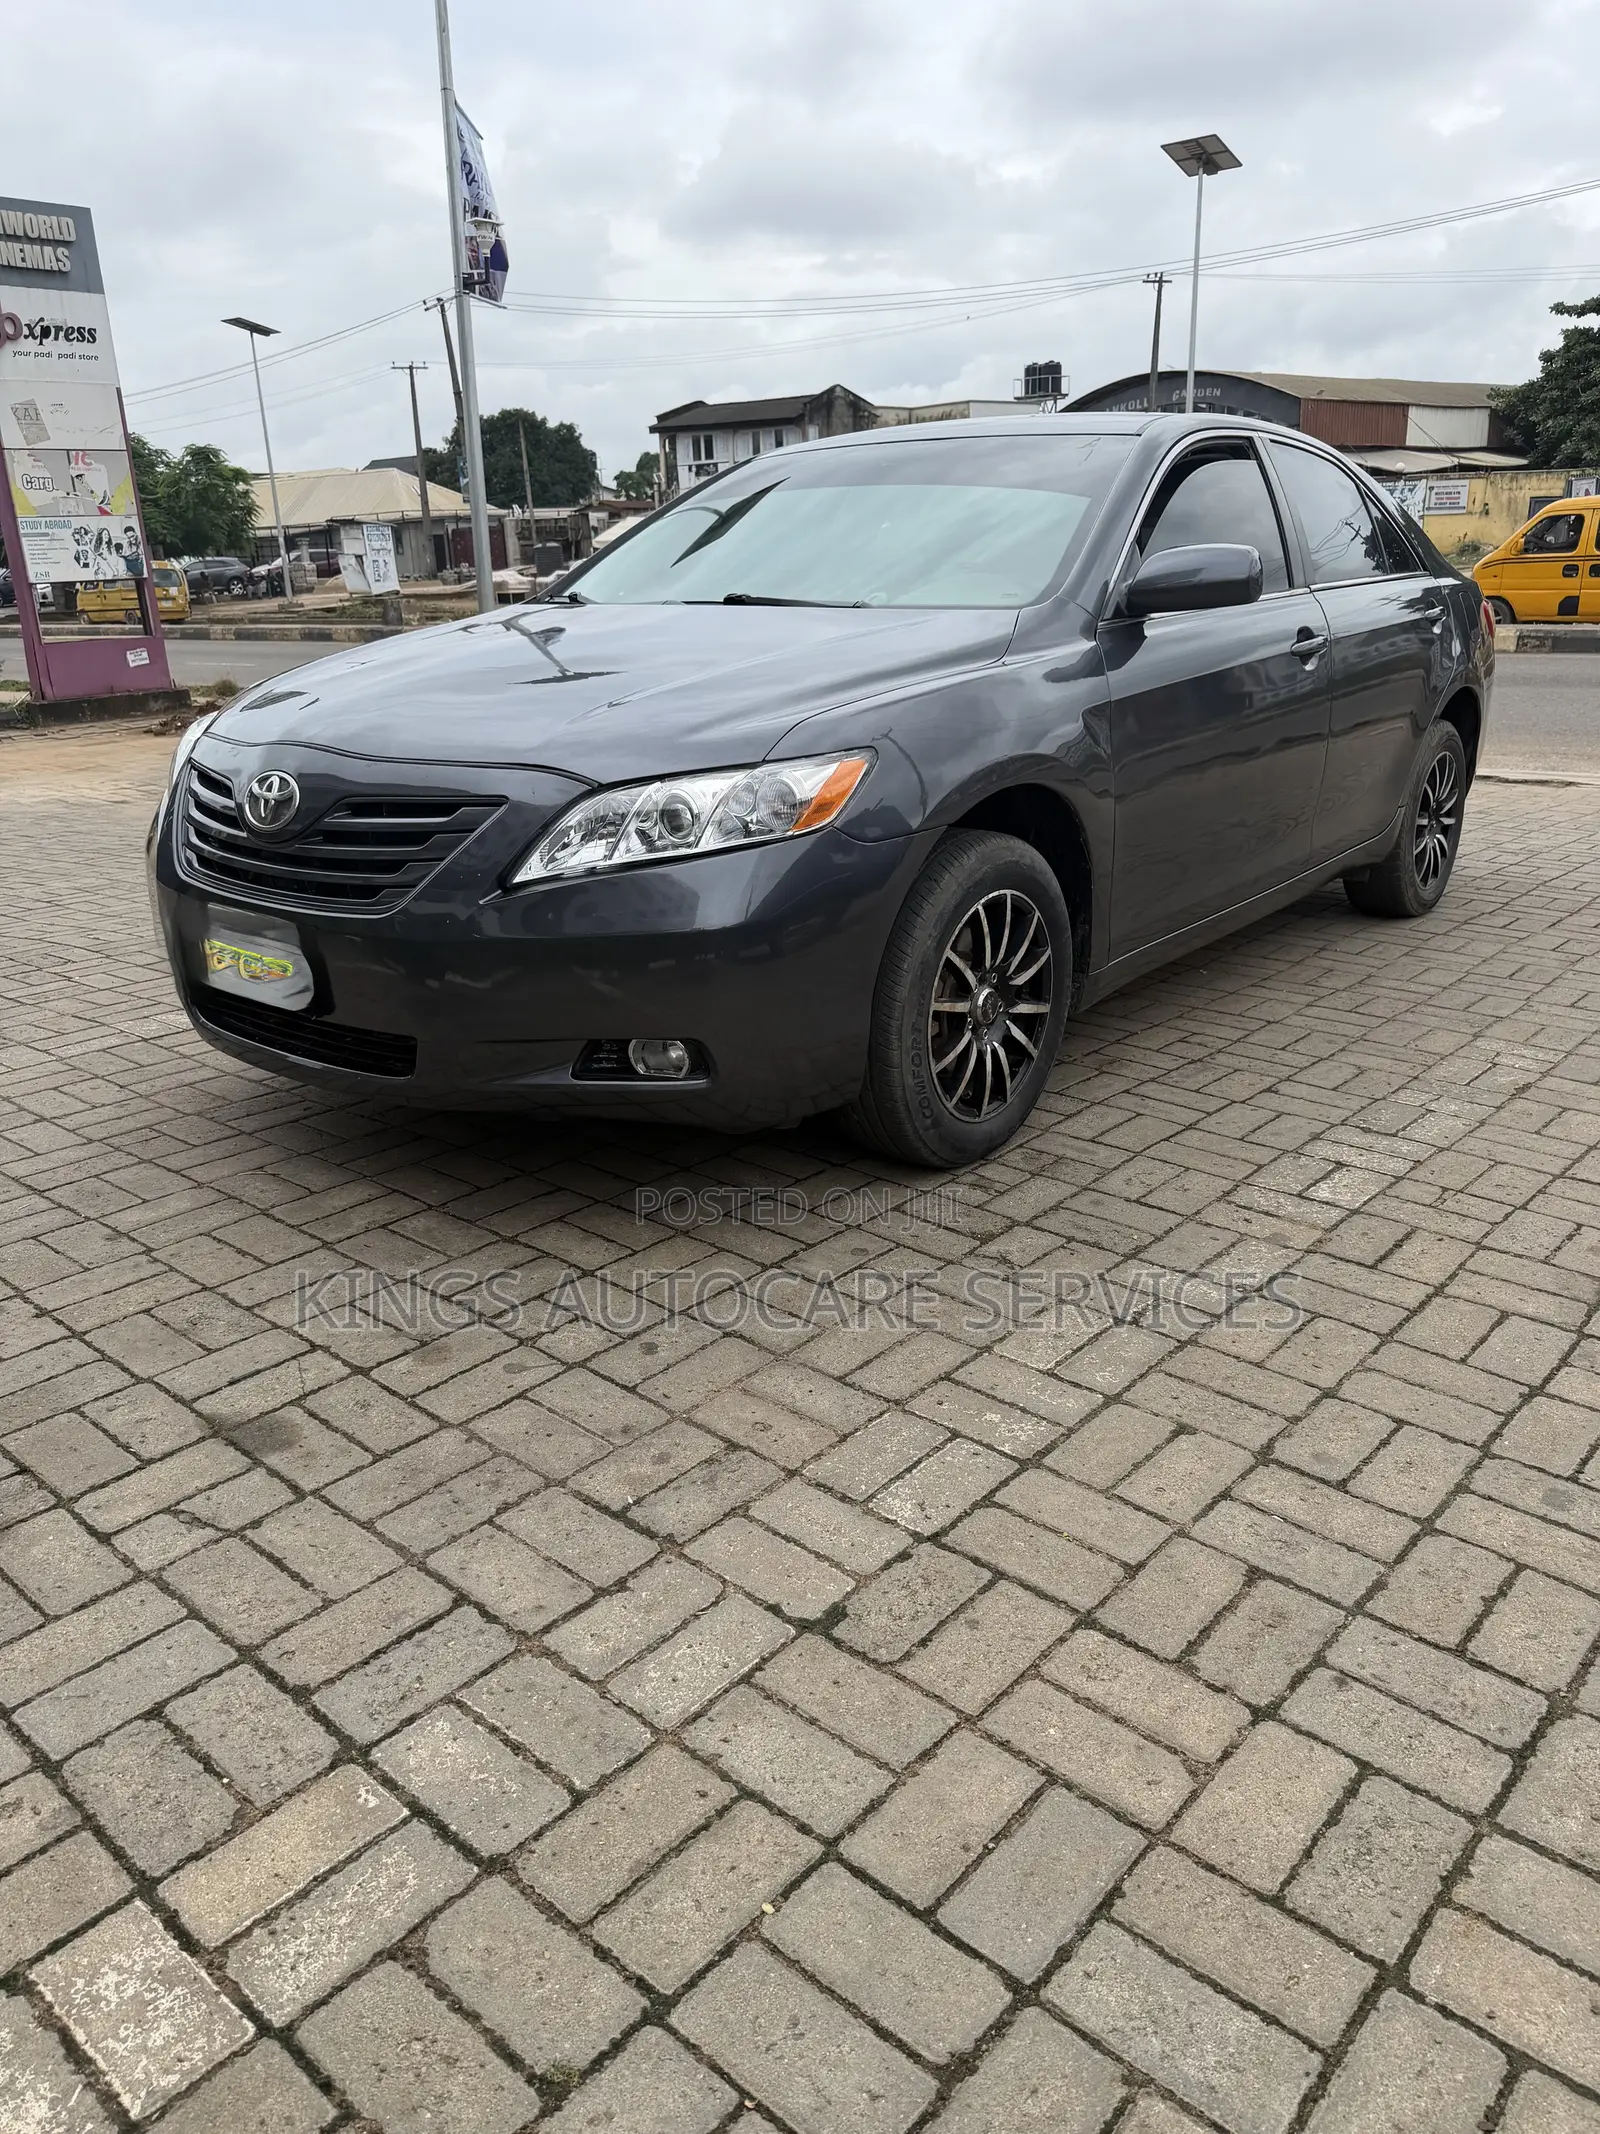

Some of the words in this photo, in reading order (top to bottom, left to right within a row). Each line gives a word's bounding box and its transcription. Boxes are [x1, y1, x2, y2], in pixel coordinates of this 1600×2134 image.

[0, 241, 71, 272] NEMAS
[12, 350, 32, 358] your
[34, 351, 53, 359] padi
[57, 352, 77, 360] padi
[20, 520, 42, 530] STUDY
[45, 519, 72, 529] ABROAD
